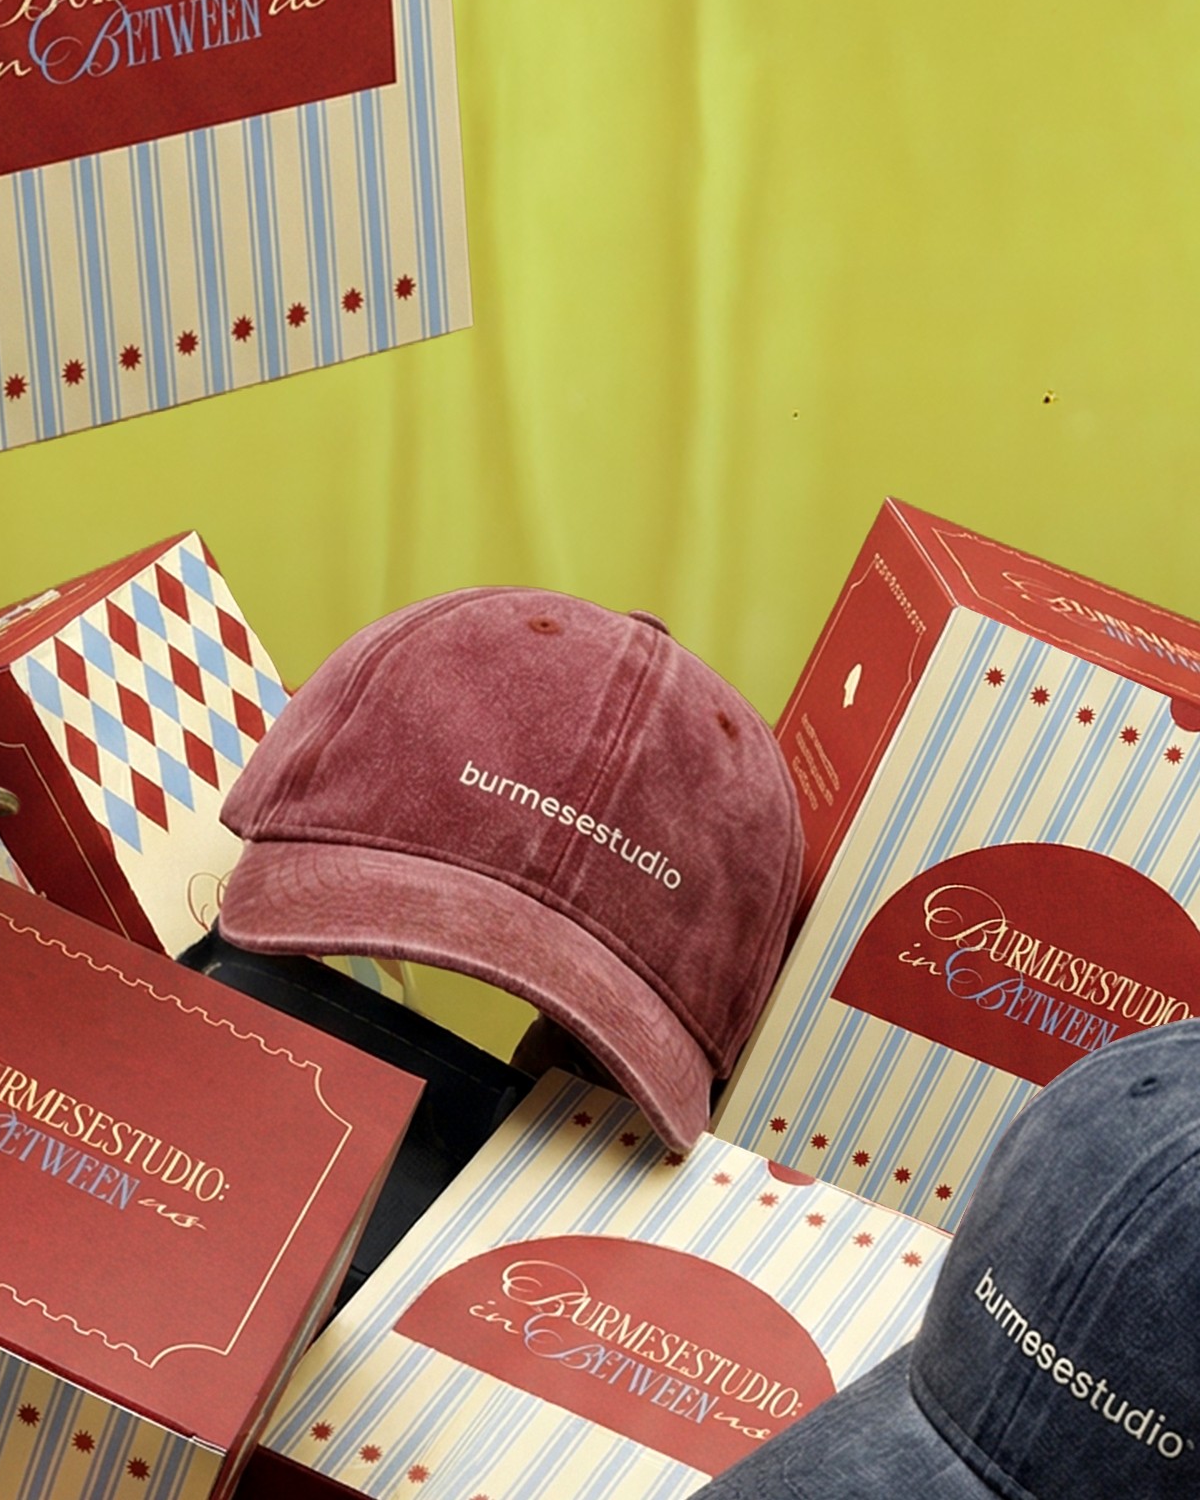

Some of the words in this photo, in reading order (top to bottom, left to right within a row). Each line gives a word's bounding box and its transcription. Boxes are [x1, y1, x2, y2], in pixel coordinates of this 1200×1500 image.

[459, 760, 682, 890] burmesestudio
[898, 942, 942, 975] in
[945, 947, 1120, 1052] BETWEEN
[137, 1197, 207, 1230] us
[468, 1300, 520, 1334] in
[523, 1310, 719, 1424] BETWEEN
[974, 1267, 1184, 1458] burmesestudio
